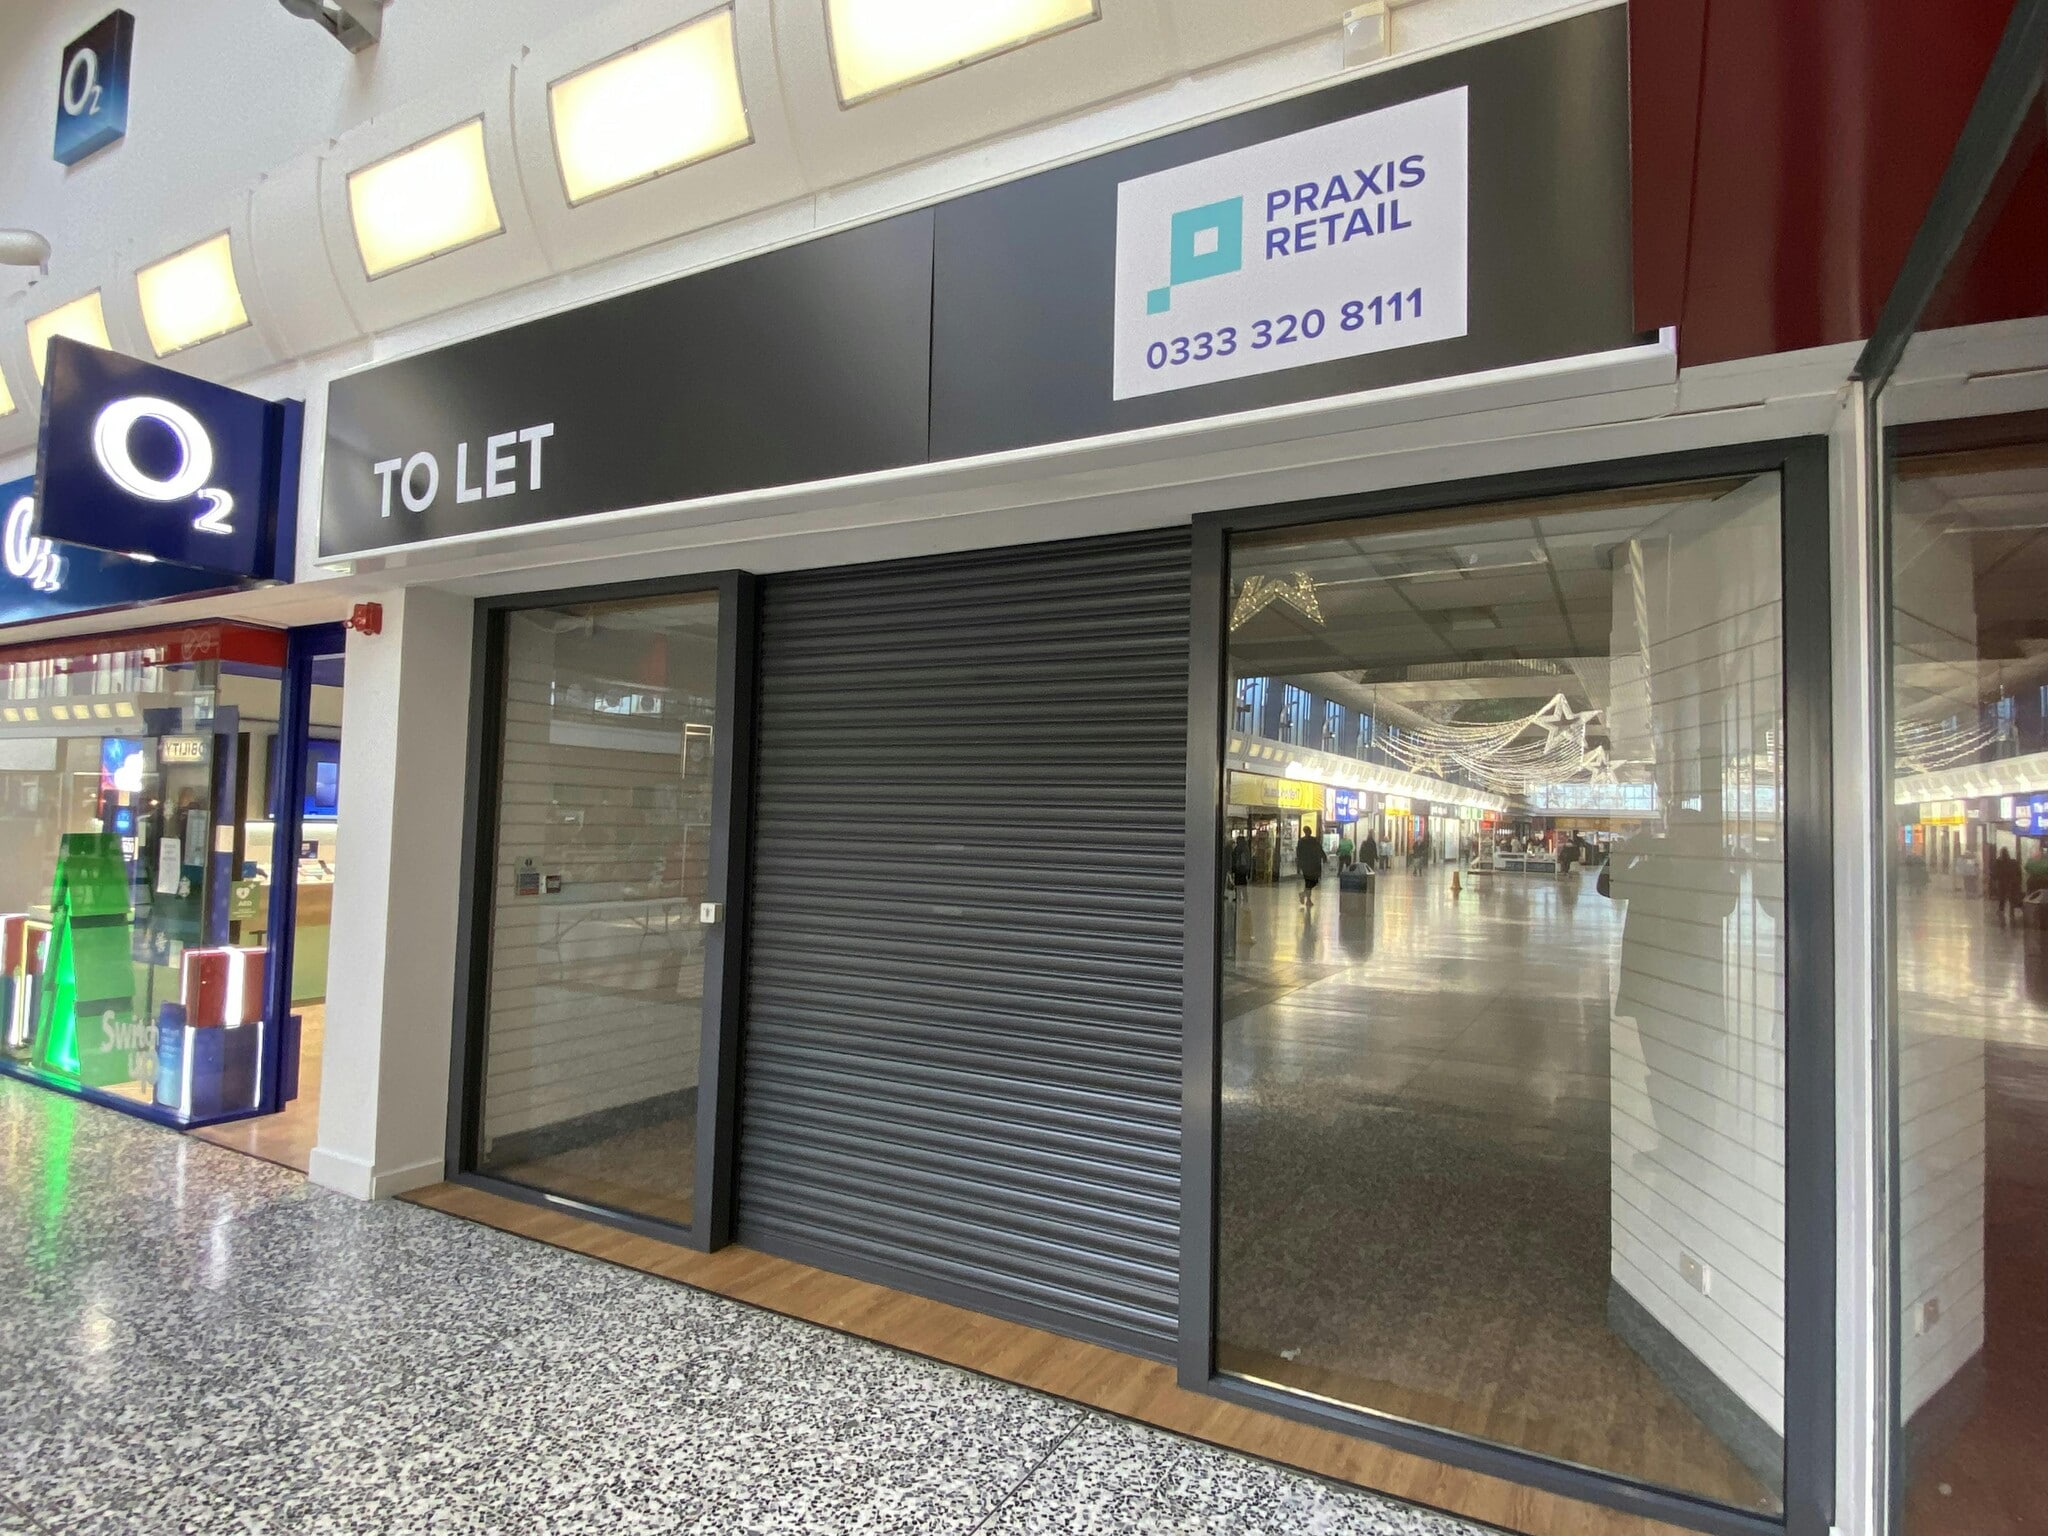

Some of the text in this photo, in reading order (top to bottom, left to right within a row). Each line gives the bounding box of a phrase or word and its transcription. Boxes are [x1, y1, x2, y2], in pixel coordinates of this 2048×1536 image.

[1266, 154, 1426, 223] PRAXIS
[1265, 199, 1412, 261] RETAIL
[1146, 287, 1423, 370] 0333 320 8111
[374, 422, 555, 518] TO LET
